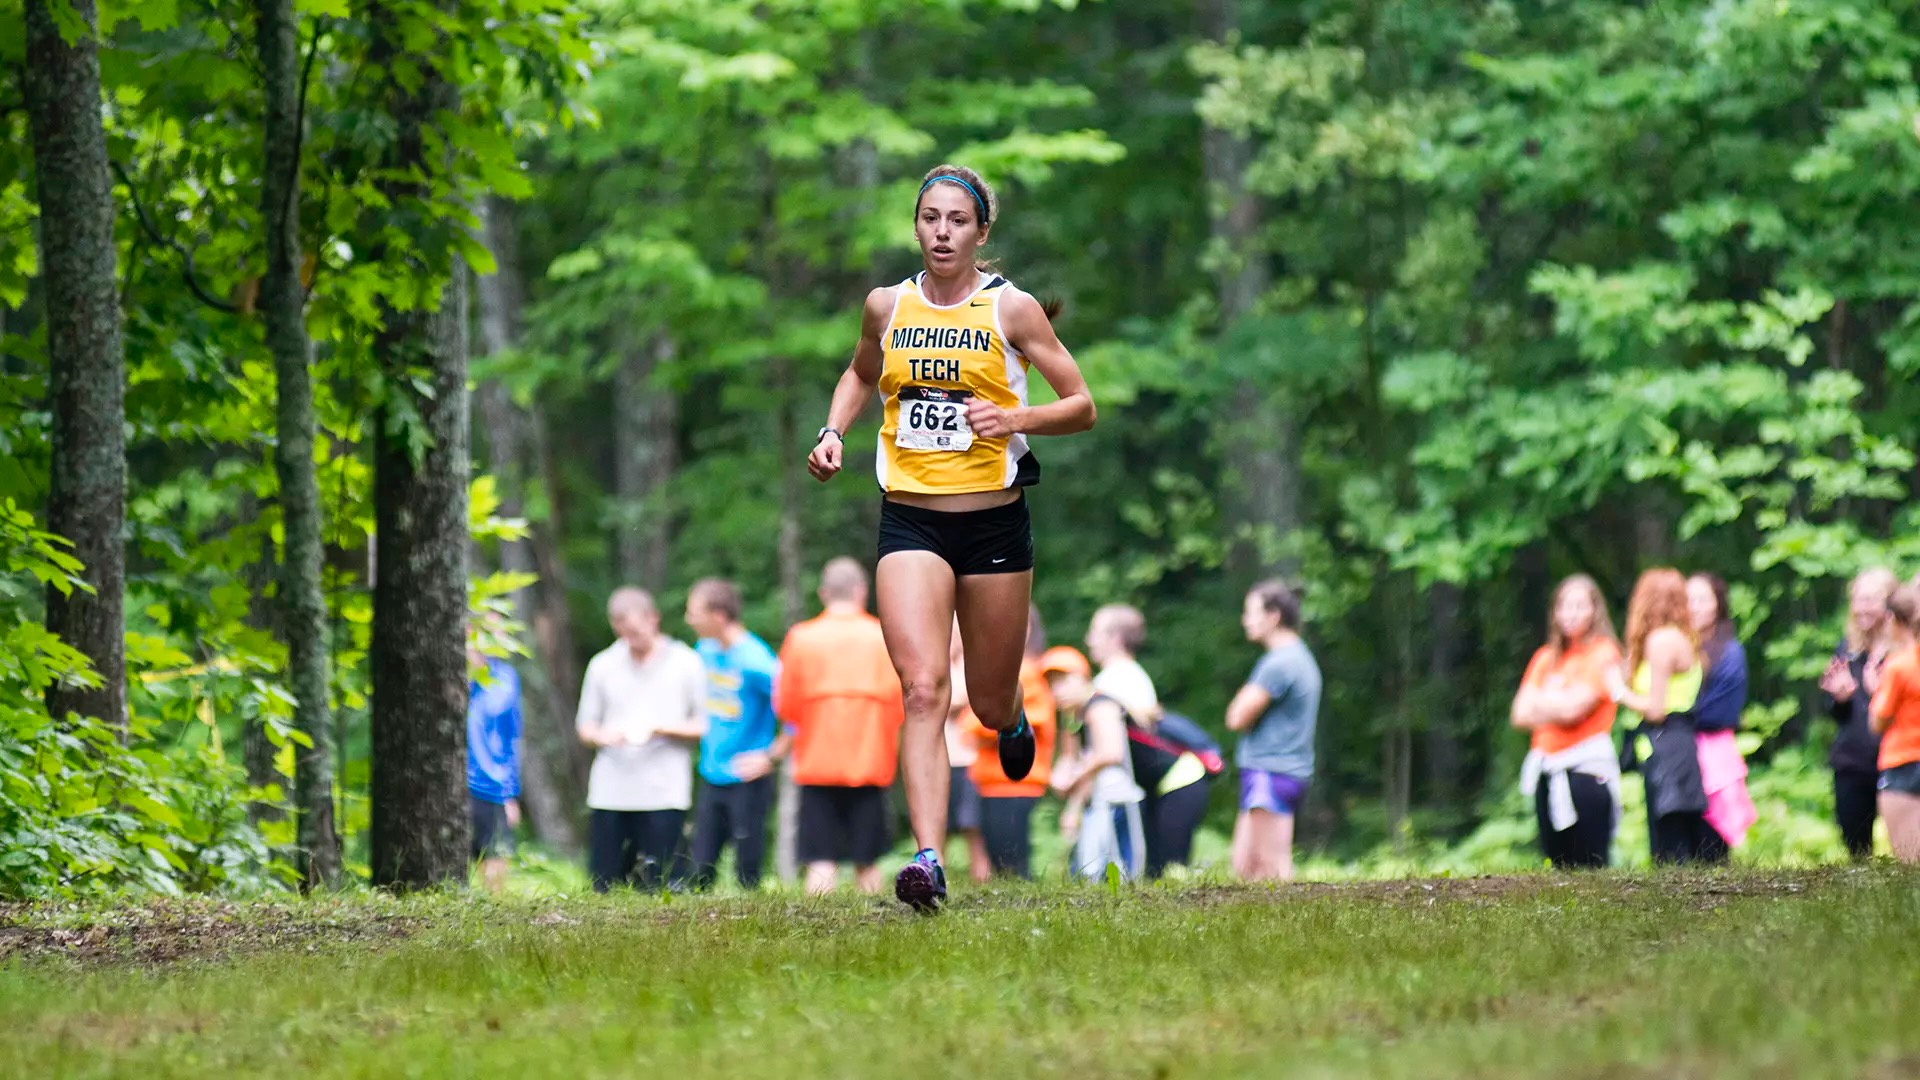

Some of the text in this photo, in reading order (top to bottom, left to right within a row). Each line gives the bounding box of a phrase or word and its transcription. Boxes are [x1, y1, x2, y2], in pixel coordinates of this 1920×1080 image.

[891, 327, 991, 352] MICHIGAN
[908, 358, 960, 381] TECH
[909, 402, 958, 431] 662
